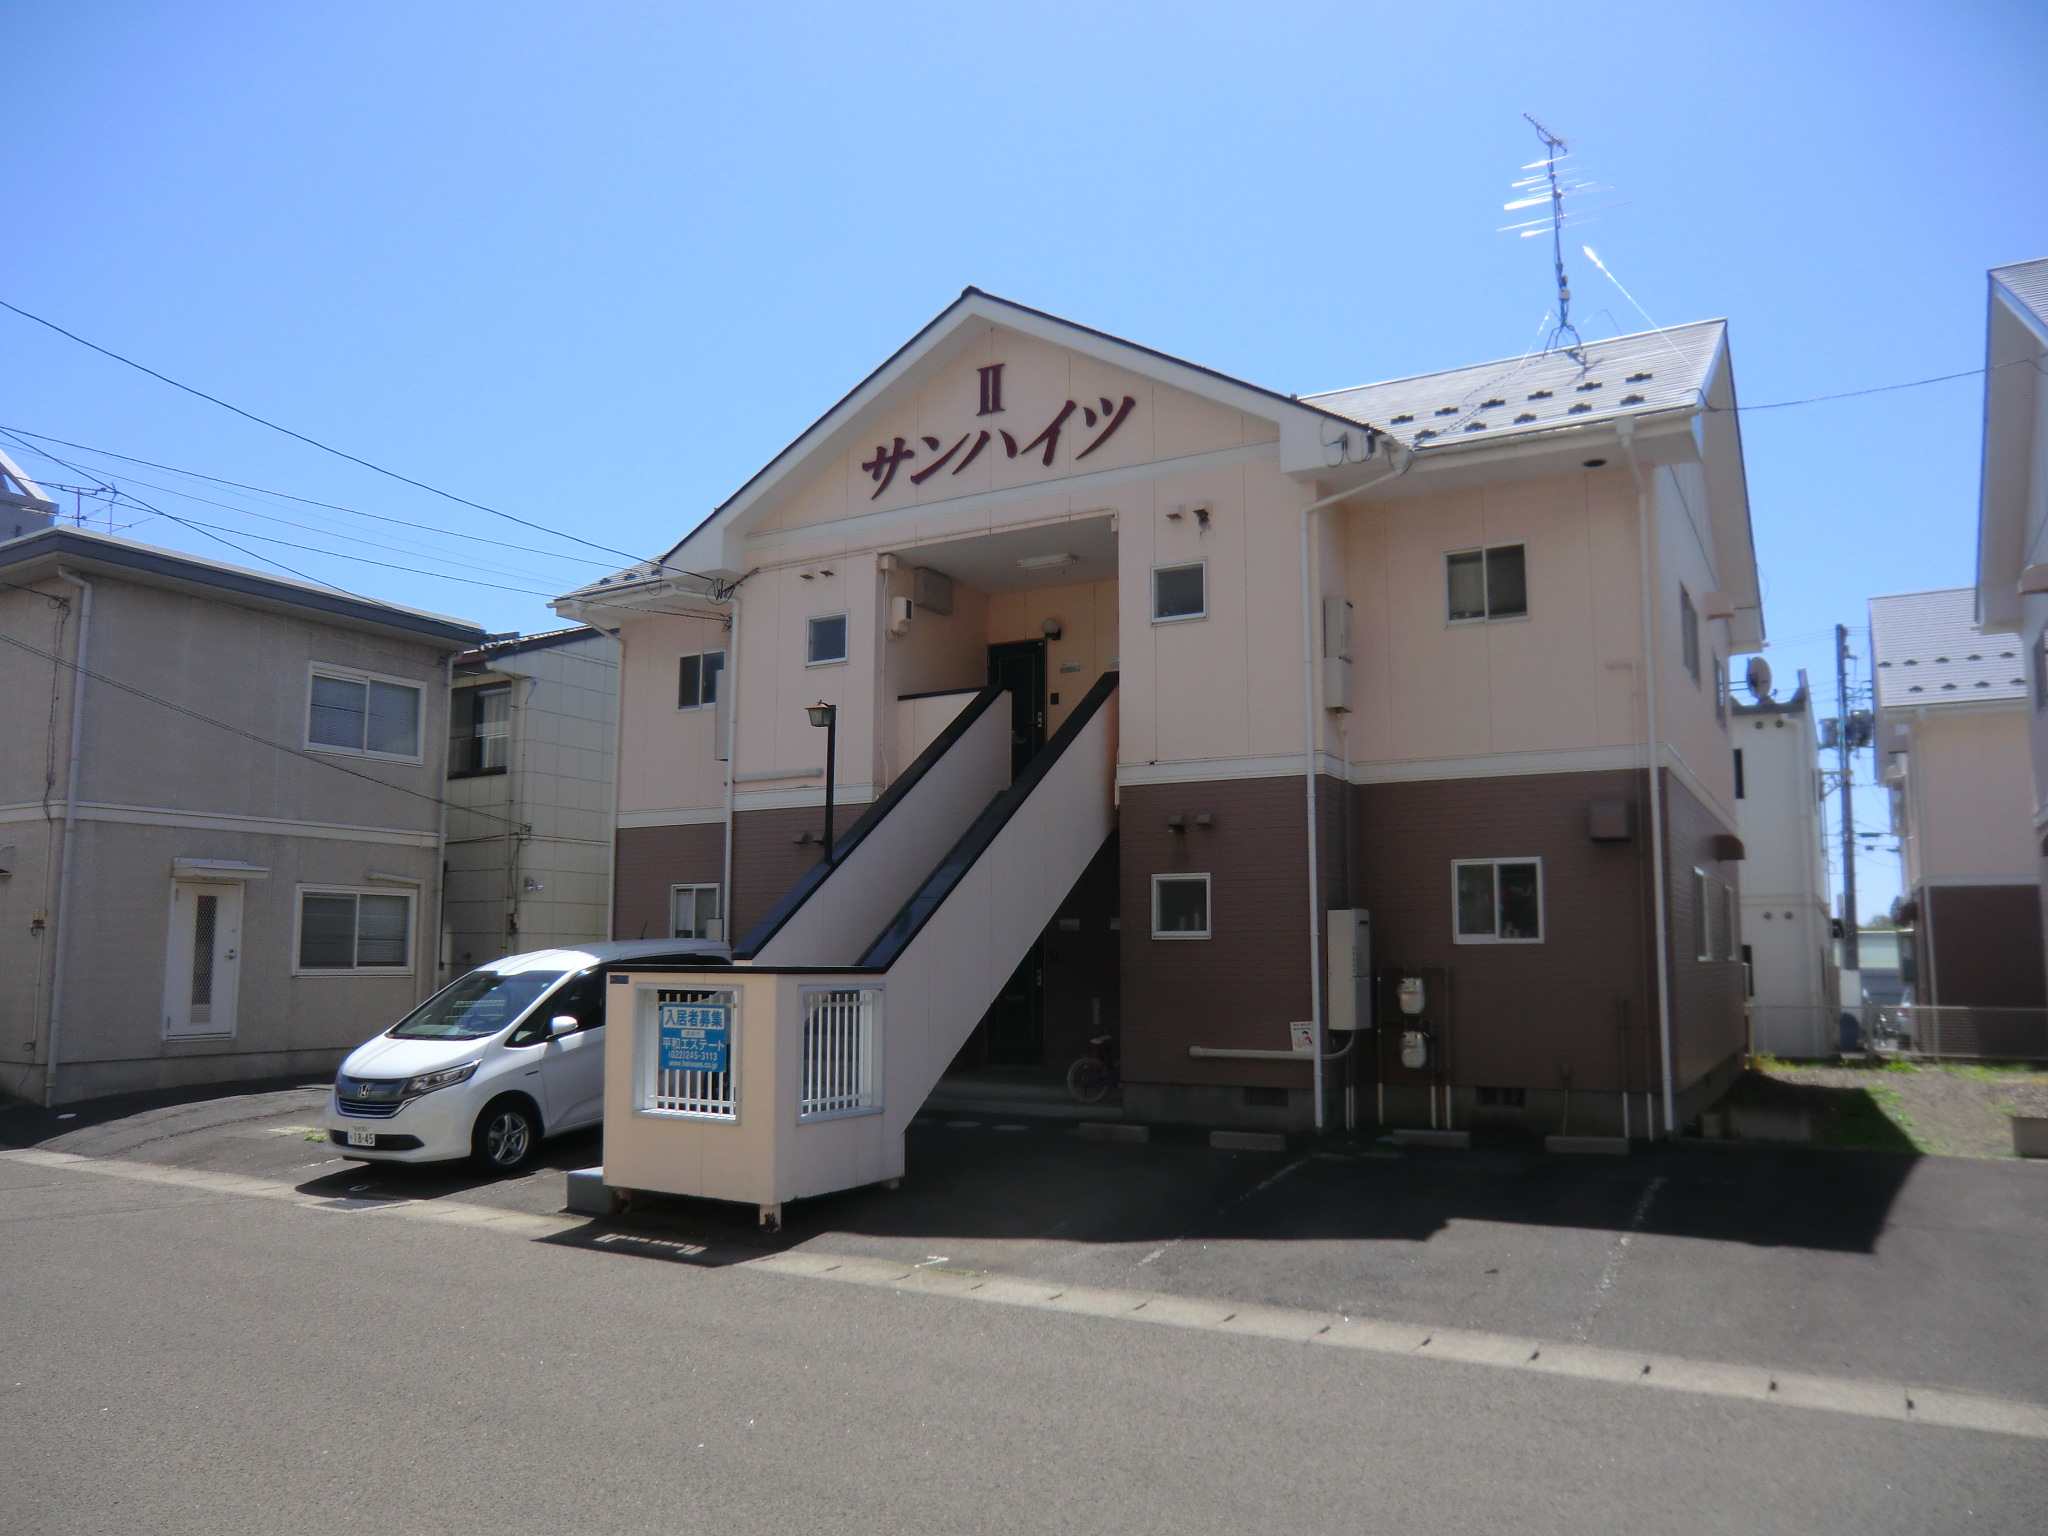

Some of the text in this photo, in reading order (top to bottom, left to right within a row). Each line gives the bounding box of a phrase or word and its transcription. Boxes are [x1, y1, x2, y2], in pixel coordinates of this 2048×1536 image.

[862, 396, 1136, 500] サンハイツ
[665, 1009, 723, 1027] 入居者募集
[662, 1037, 725, 1051] 平和エステート
